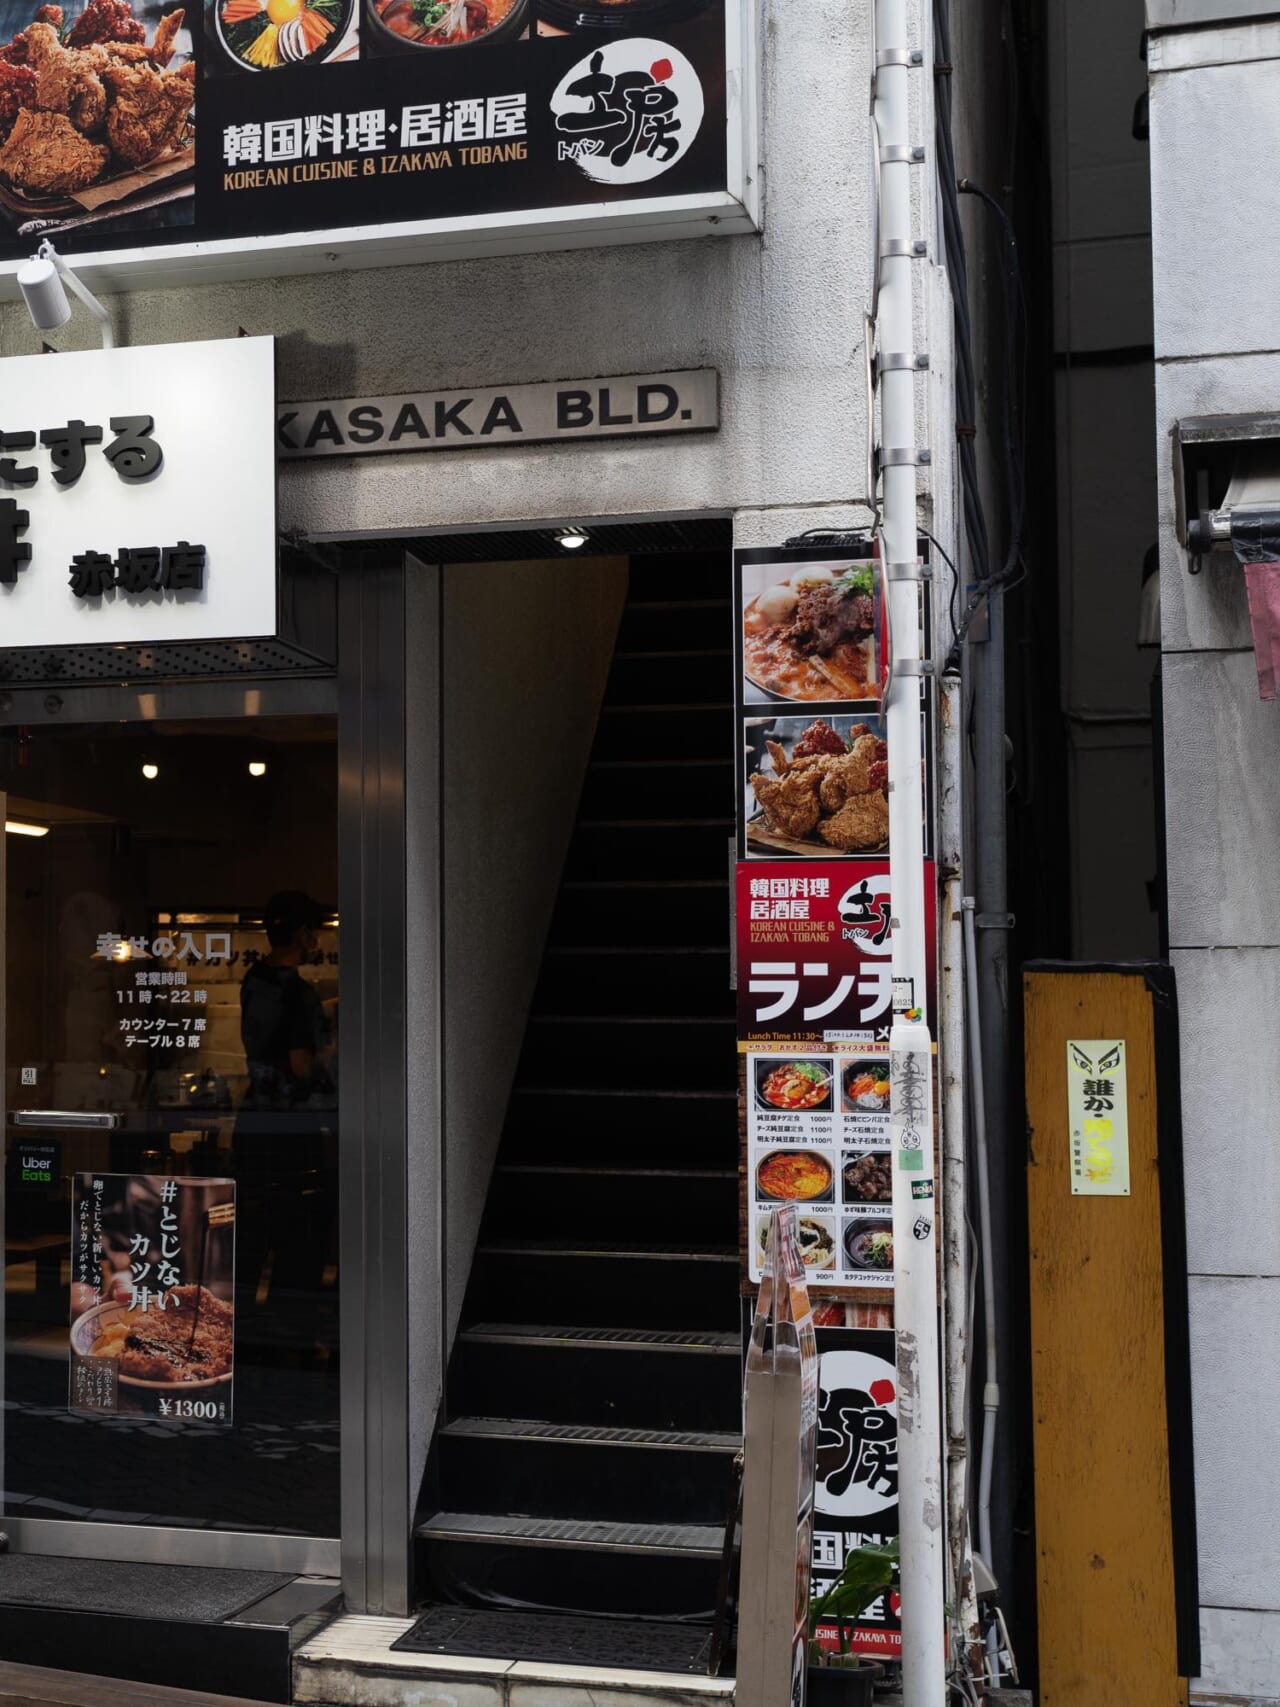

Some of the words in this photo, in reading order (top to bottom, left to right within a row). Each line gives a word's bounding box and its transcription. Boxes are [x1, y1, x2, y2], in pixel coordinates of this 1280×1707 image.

[223, 93, 527, 166] 韓国料理・居酒屋
[558, 137, 604, 160] トバン
[224, 167, 288, 190] KOREAN
[293, 160, 358, 184] CUISINE
[363, 158, 375, 175] &
[380, 150, 452, 174] IZAKAYA
[458, 142, 527, 166] TOBANG
[556, 384, 692, 429] BLD.
[69, 541, 207, 600] 赤坂店
[750, 878, 830, 898] 韓国料理
[750, 900, 810, 920] 居酒屋
[750, 922, 787, 931] KOREAN
[789, 921, 825, 931] CUISINE
[827, 921, 835, 931] &
[96, 932, 231, 960] 幸せの入口
[750, 932, 789, 943] IZAKAYA
[792, 932, 829, 943] TOBANG
[135, 972, 187, 986] 営業時間
[749, 962, 893, 1023] ランチ
[748, 1032, 771, 1040] Lunch
[772, 1032, 791, 1040] Time
[22, 1156, 51, 1169] Uber
[22, 1169, 51, 1181] Eats
[157, 1181, 181, 1310] #とじない
[128, 1234, 152, 1312] カツ丼
[159, 1398, 217, 1418] ¥1300
[853, 1632, 887, 1643] ZAKAYA
